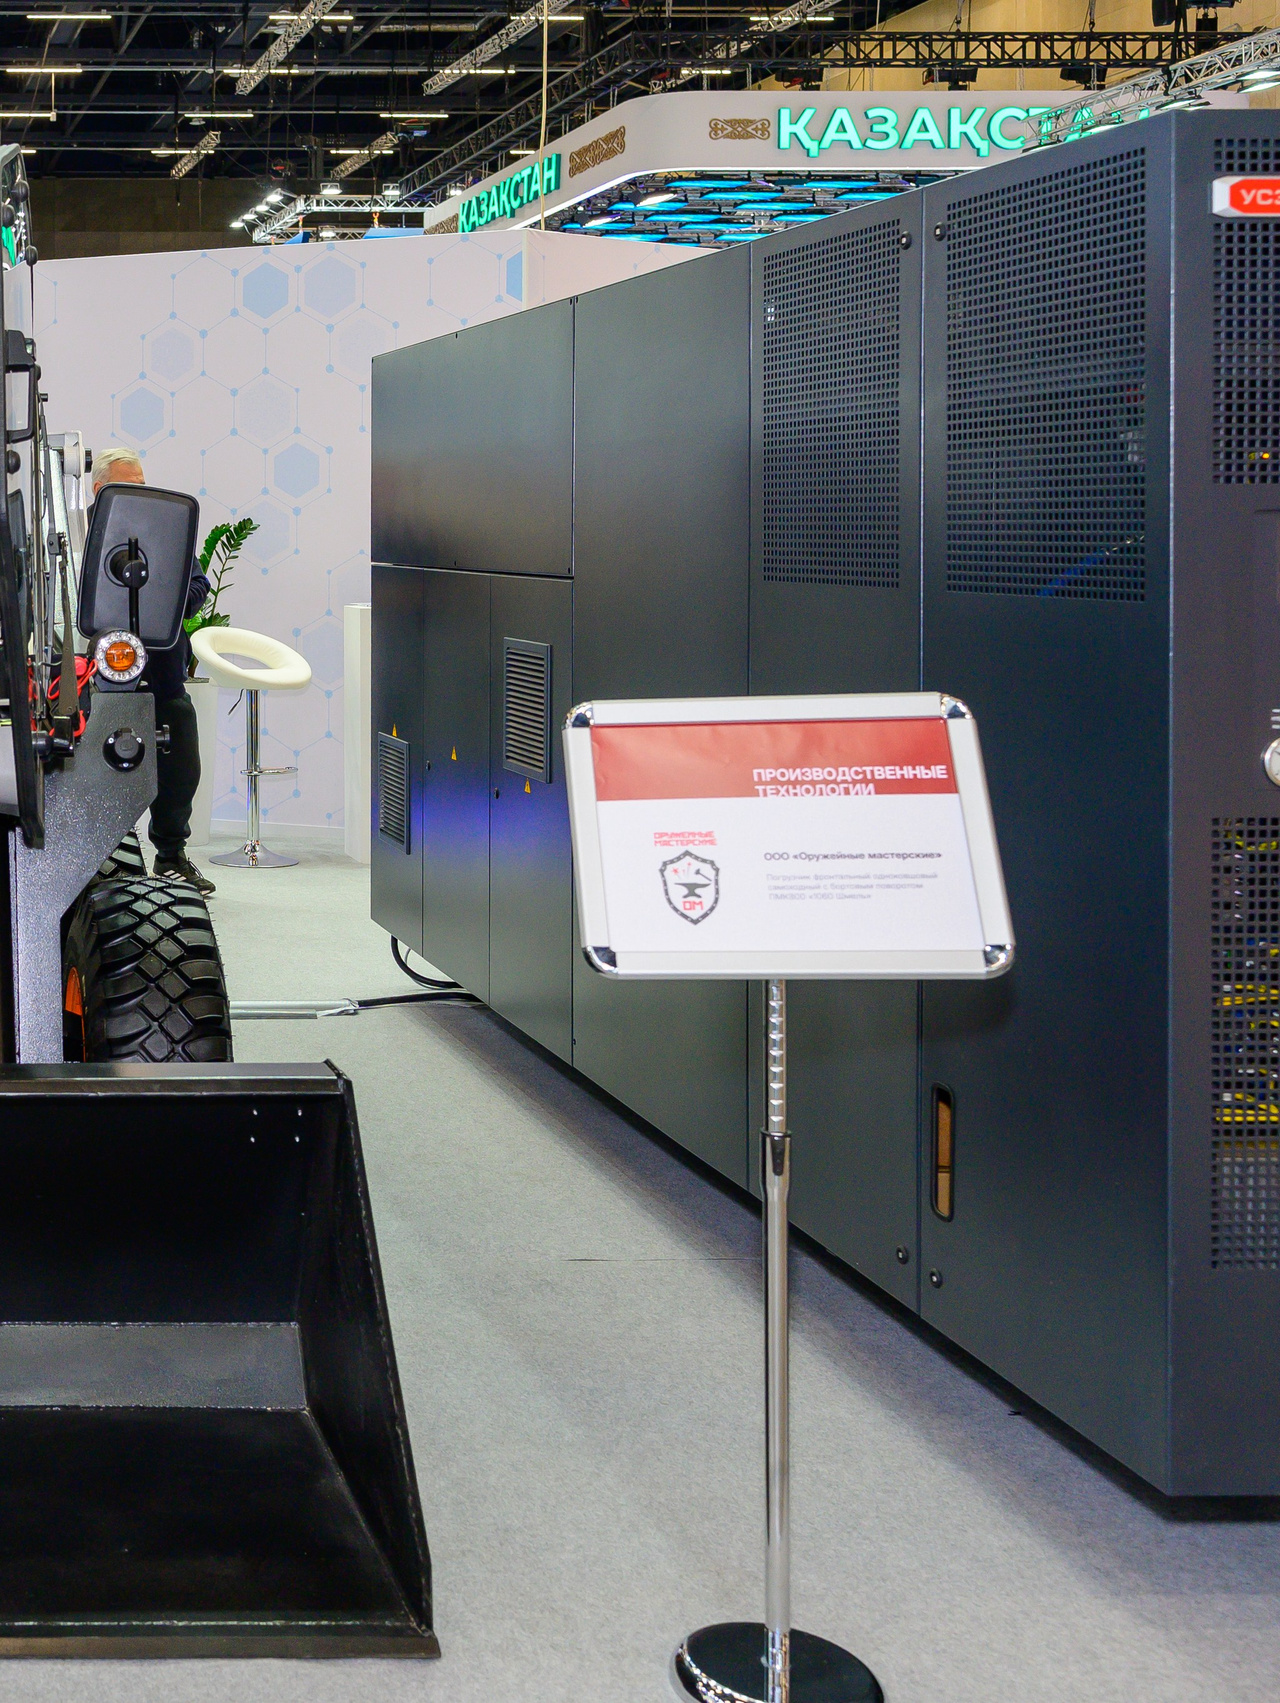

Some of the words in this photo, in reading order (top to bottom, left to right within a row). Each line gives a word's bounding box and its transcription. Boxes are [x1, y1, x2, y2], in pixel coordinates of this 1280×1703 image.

[752, 765, 949, 782] ПРОИЗВОДСТВЕННЫЕ
[754, 783, 876, 798] ТЕХНОЛОГИИ
[763, 852, 790, 861] ООО
[792, 851, 865, 862] «Оружейные
[867, 852, 943, 861] мастерские»
[682, 900, 704, 911] ОМ
